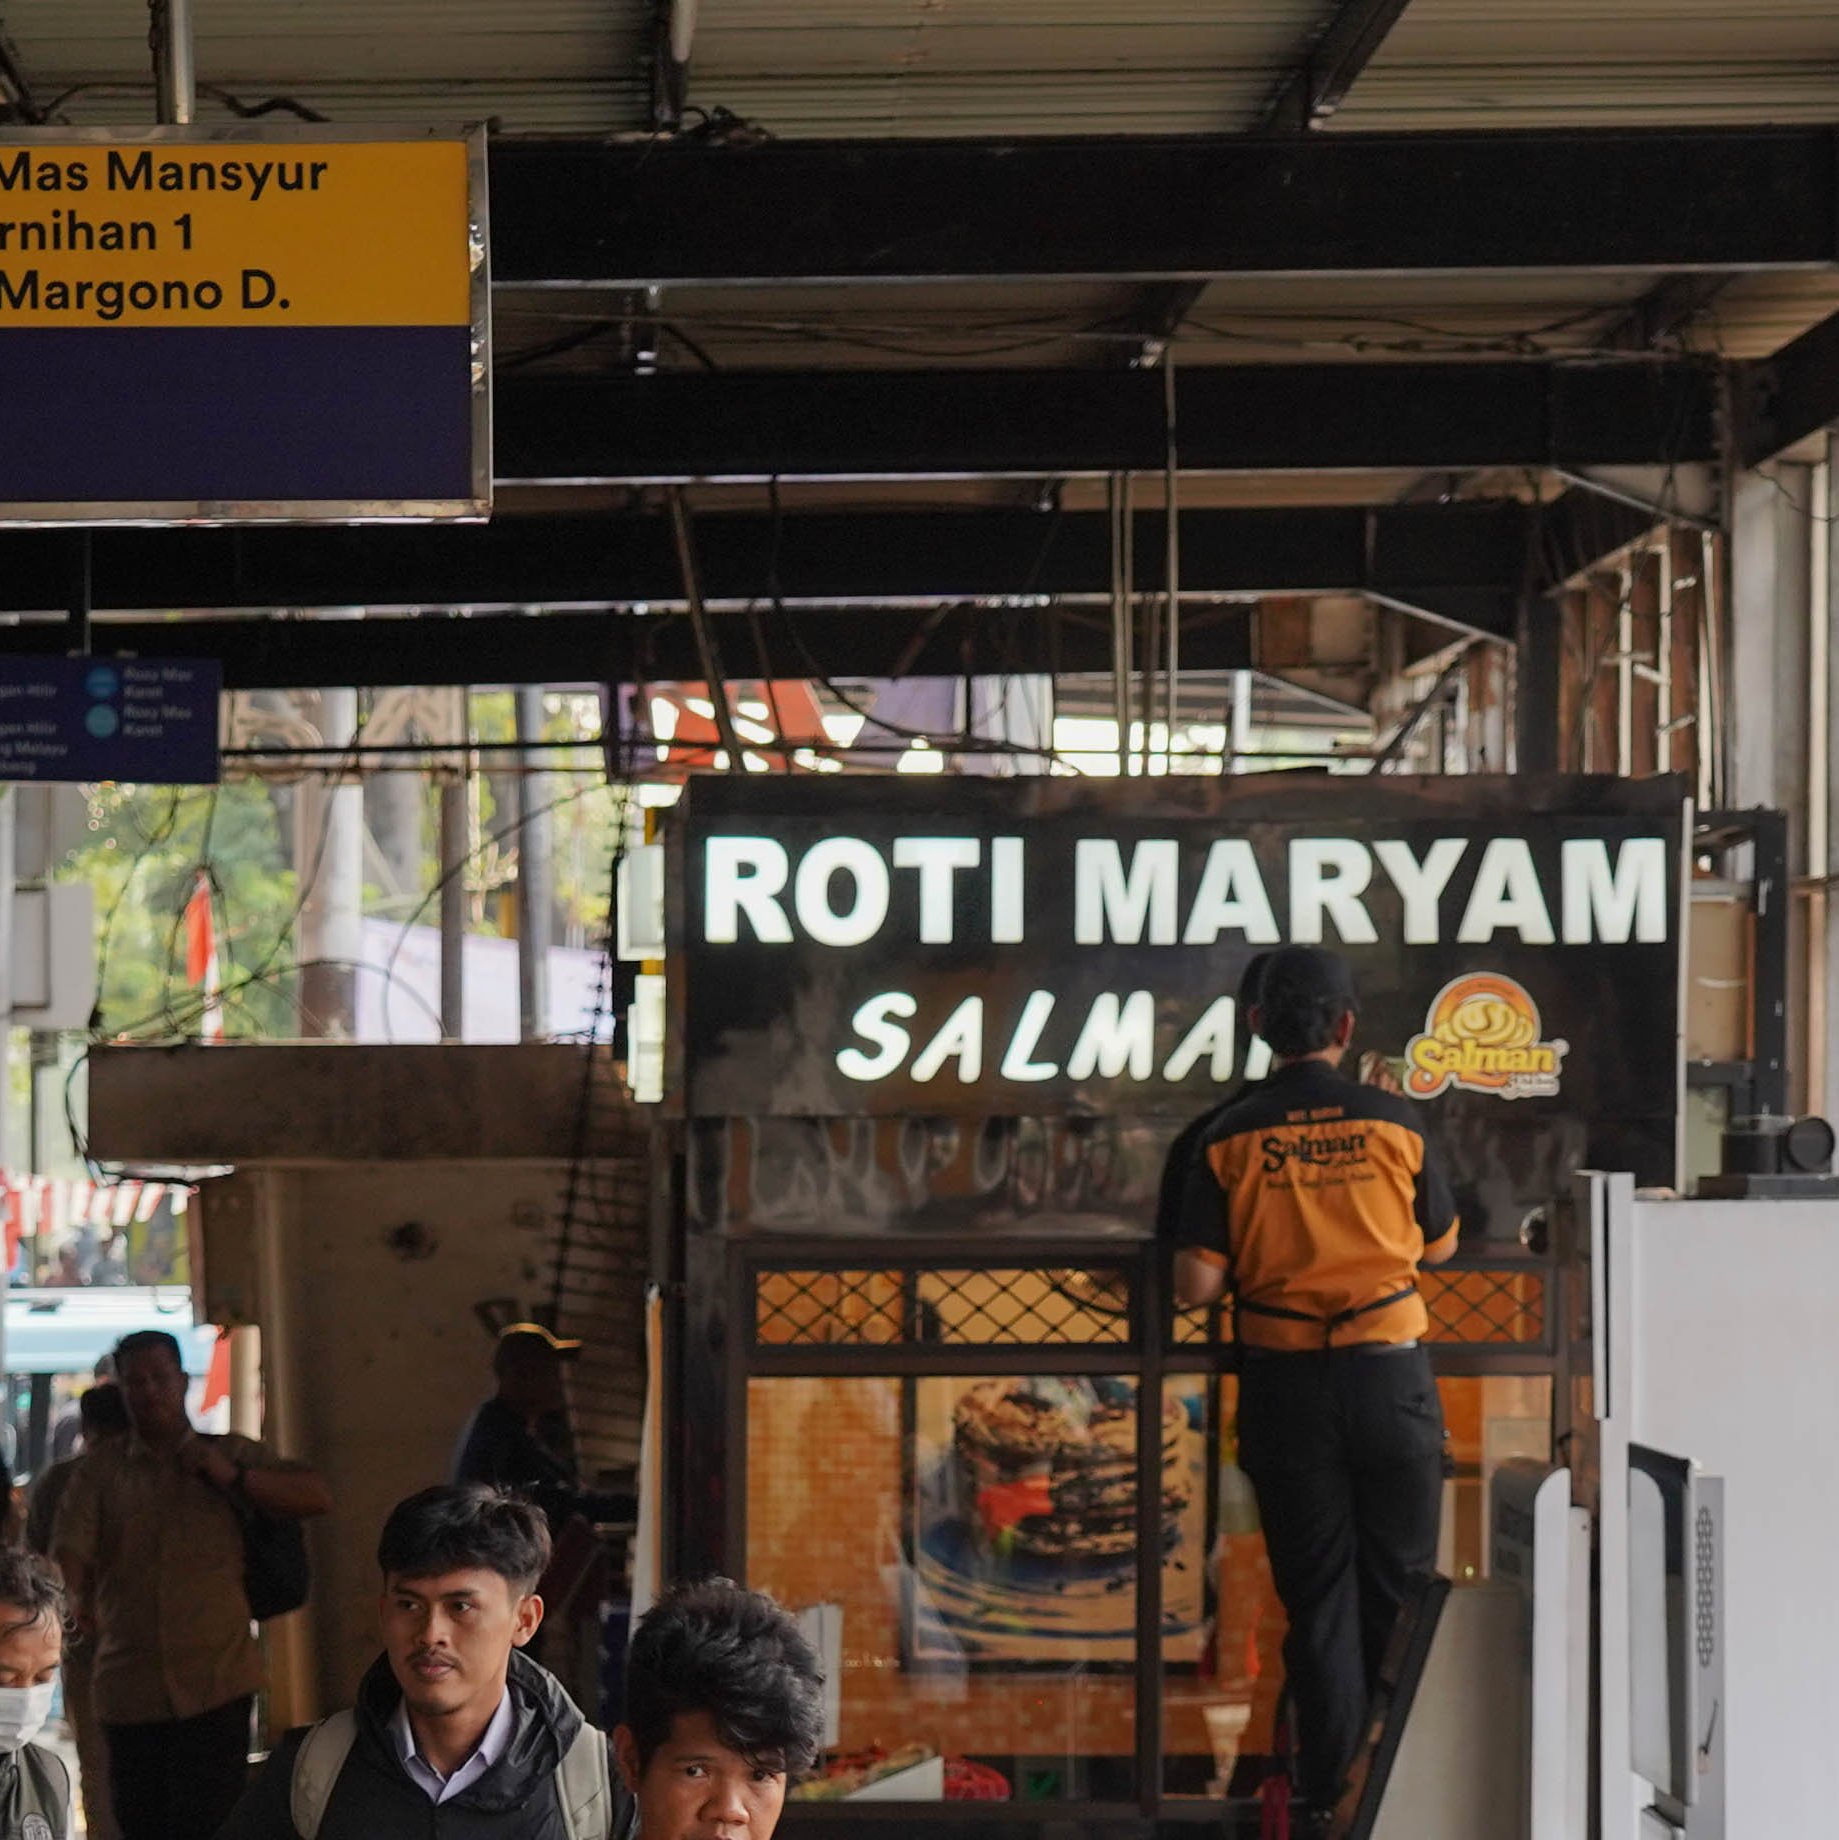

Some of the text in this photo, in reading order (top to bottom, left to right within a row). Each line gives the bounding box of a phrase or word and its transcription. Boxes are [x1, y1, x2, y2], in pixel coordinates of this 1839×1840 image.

[107, 150, 328, 202] Mansyur
[173, 212, 195, 251] 1
[241, 269, 291, 311] D.
[704, 836, 1667, 945] ROTI MARYAM
[1409, 1038, 1554, 1093] Salman
